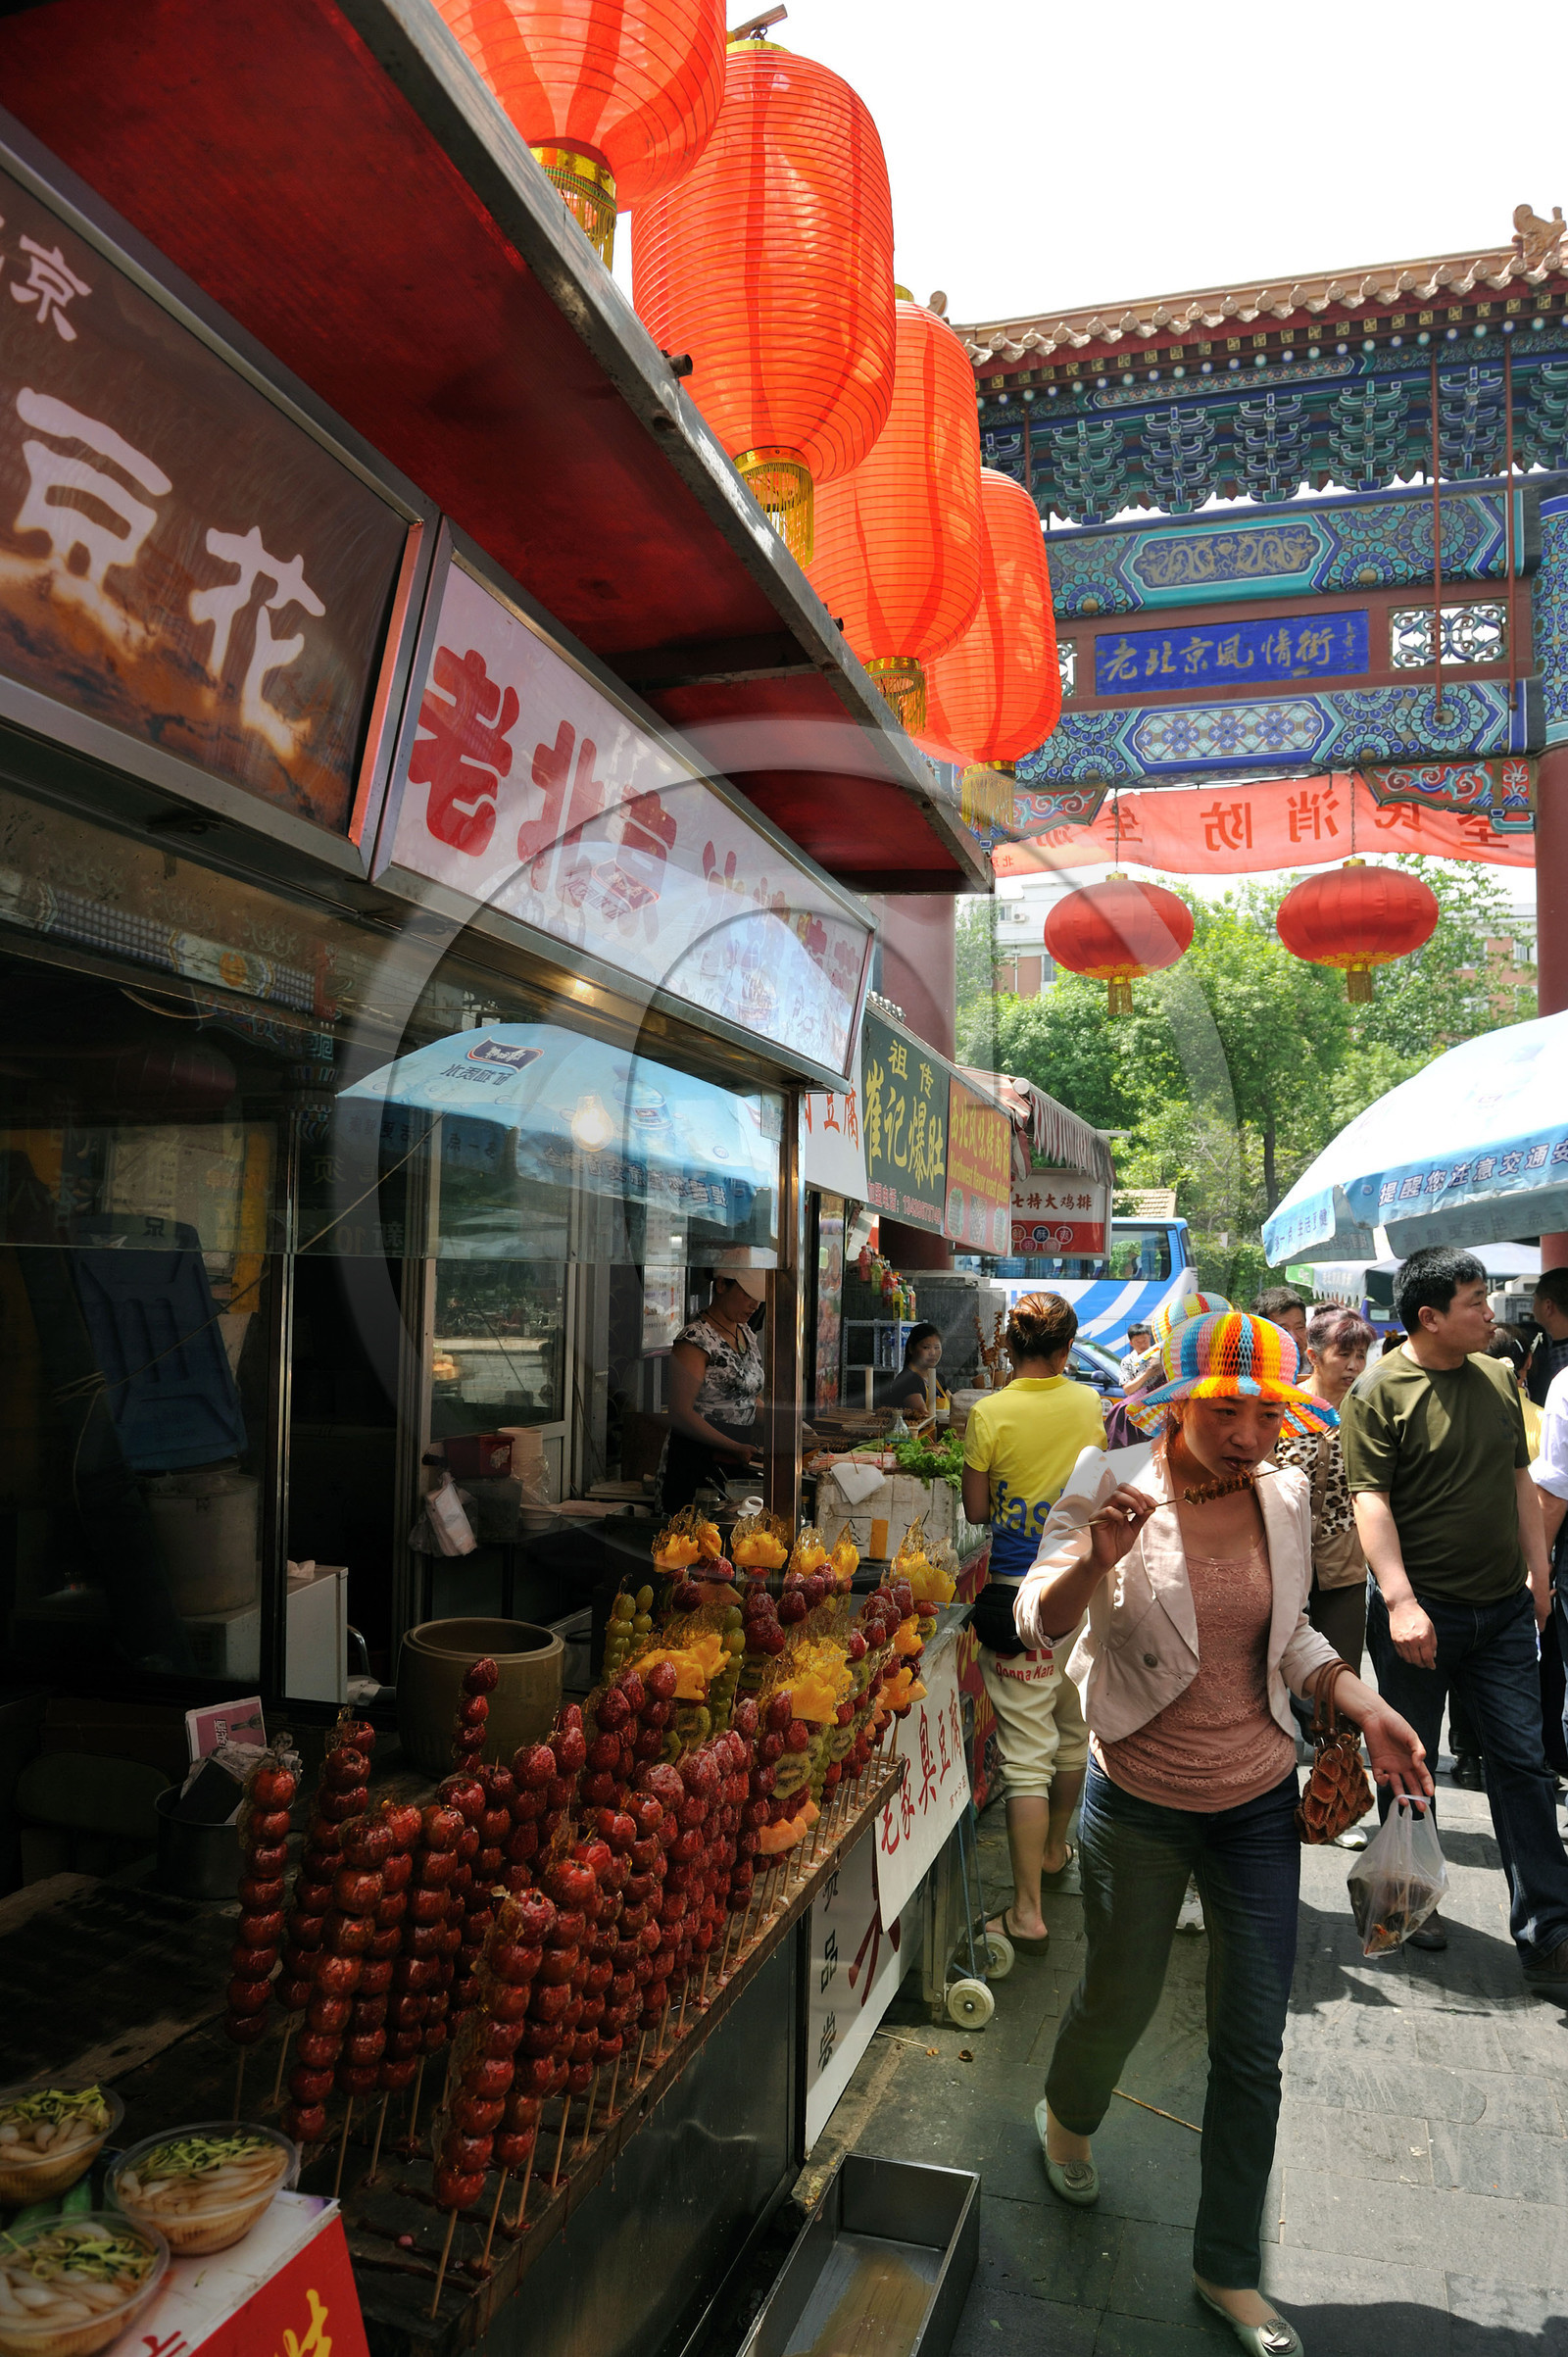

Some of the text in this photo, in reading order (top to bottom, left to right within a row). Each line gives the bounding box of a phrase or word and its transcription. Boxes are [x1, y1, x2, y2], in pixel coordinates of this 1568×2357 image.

[0, 218, 91, 341] 京
[14, 387, 325, 756] 豆花
[887, 1039, 934, 1100] 祖传
[805, 1077, 858, 1153] 豆腐
[862, 1058, 945, 1191] 崔记爆肚
[993, 1480, 1064, 1537] fas
[996, 1661, 1032, 1682] Donna
